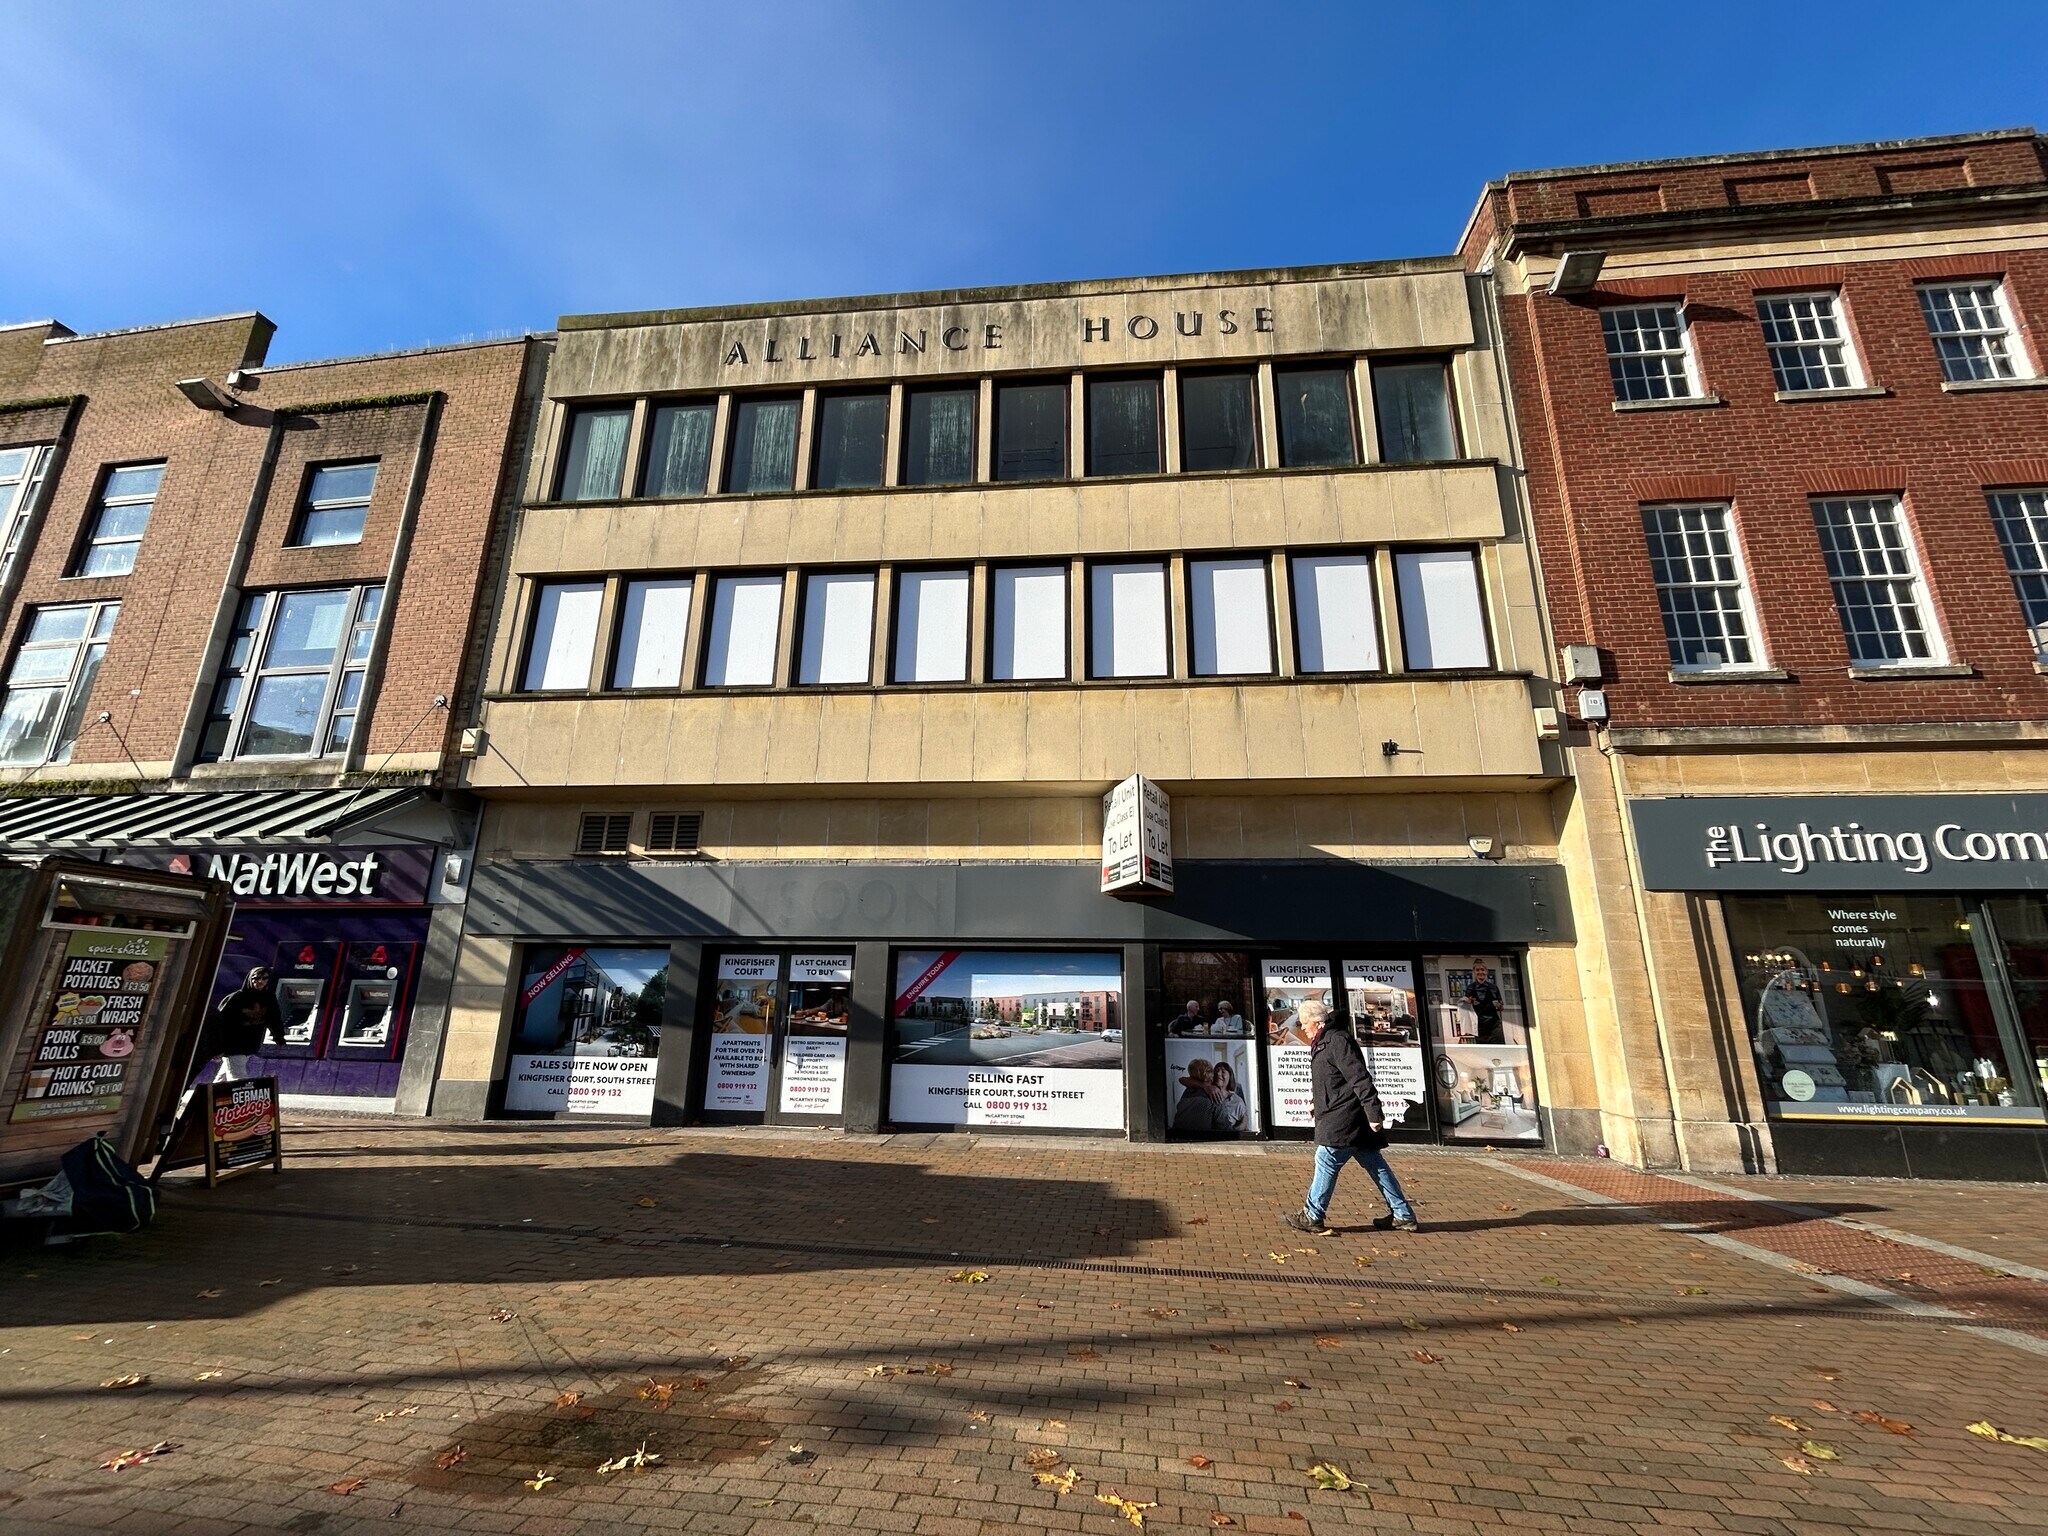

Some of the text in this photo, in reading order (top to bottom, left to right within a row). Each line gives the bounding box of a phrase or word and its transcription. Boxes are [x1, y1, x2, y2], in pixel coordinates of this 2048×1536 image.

[724, 307, 1275, 366] ALLIANCE HOUSE
[1108, 830, 1133, 855] To Let
[1147, 828, 1168, 856] To Let
[1706, 825, 1731, 867] The
[1730, 822, 2048, 873] Lighting Com
[207, 852, 378, 896] NatWest
[1828, 910, 1897, 921] Where style
[1832, 925, 1868, 934] comes
[1835, 937, 1886, 949] naturally
[67, 959, 113, 974] JACKET
[734, 968, 764, 976] COURT
[1270, 966, 1326, 974] KINGFISHER
[62, 974, 122, 989] POTATOES
[528, 954, 574, 998] NOW SELLING
[906, 960, 945, 999] ENQUIRE TODAY
[1282, 976, 1316, 984] COURT
[106, 996, 144, 1008] FRESH
[100, 1011, 140, 1024] WRAPS
[44, 1030, 80, 1044] PORK
[39, 1046, 80, 1060] ROLLS
[54, 1064, 122, 1080] HOT & COLD
[530, 1060, 648, 1072] SALES SUITE NOW OPEN
[518, 1074, 565, 1082] KINGFISHER
[597, 1076, 625, 1084] SOUTH
[626, 1077, 656, 1085] STREET
[968, 1074, 1044, 1085] SELLING FAST
[48, 1080, 95, 1096] DRINKS
[568, 1088, 589, 1096] 0800
[591, 1088, 605, 1096] 919
[928, 1087, 980, 1096] KINGFISHER
[1018, 1089, 1049, 1098] SOUTH
[1051, 1090, 1084, 1099] STREET
[232, 1088, 270, 1104] GERMAN
[216, 1098, 271, 1125] Hotdogs
[986, 1101, 1010, 1109] 0800
[1013, 1102, 1029, 1110] 919
[1837, 1104, 1967, 1117] www.lightingcompany.co.uk
